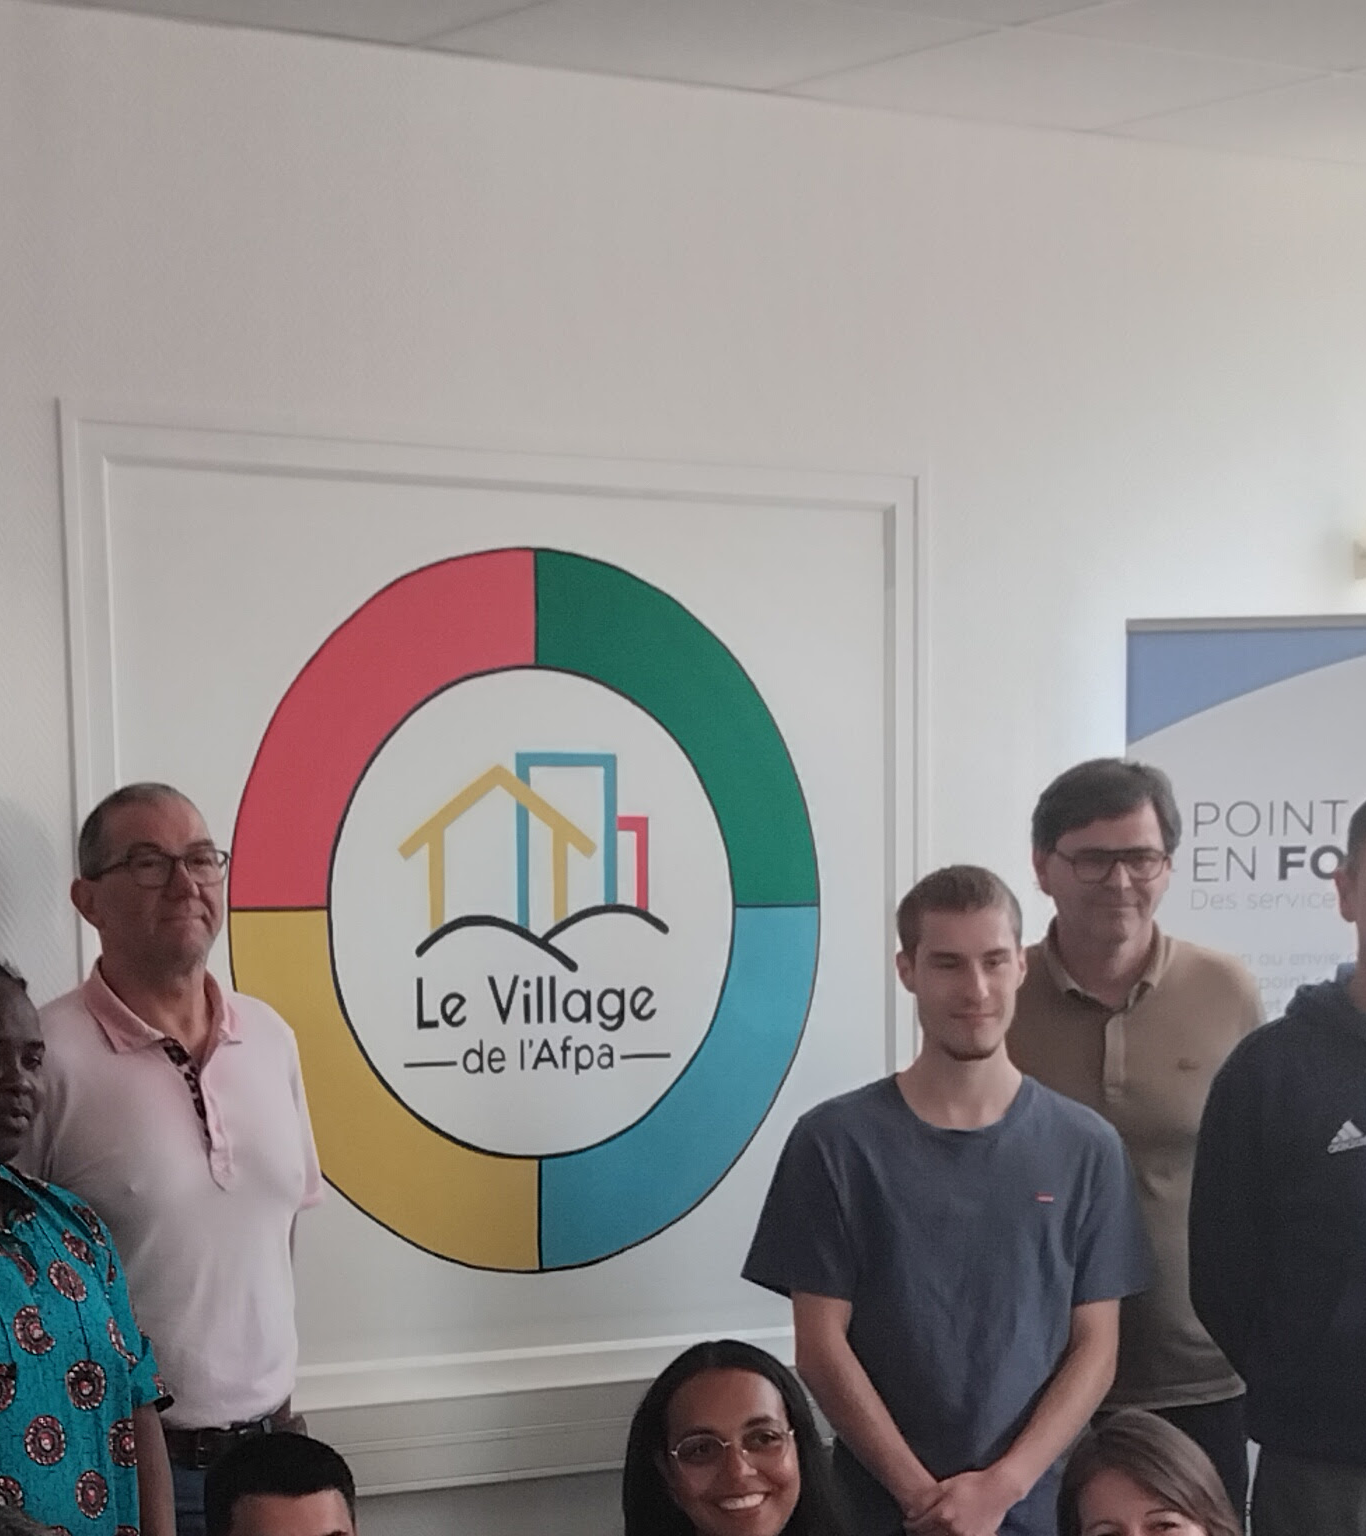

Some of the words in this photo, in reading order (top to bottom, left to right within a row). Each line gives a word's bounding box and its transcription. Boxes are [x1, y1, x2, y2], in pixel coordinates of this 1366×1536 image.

[1191, 799, 1348, 838] POINT
[1191, 845, 1257, 883] EN
[1189, 888, 1238, 911] Des
[1247, 889, 1339, 911] service
[416, 977, 467, 1030] Le
[487, 975, 658, 1032] Village
[462, 1039, 506, 1075] de
[520, 1036, 615, 1076] l'Afpa
